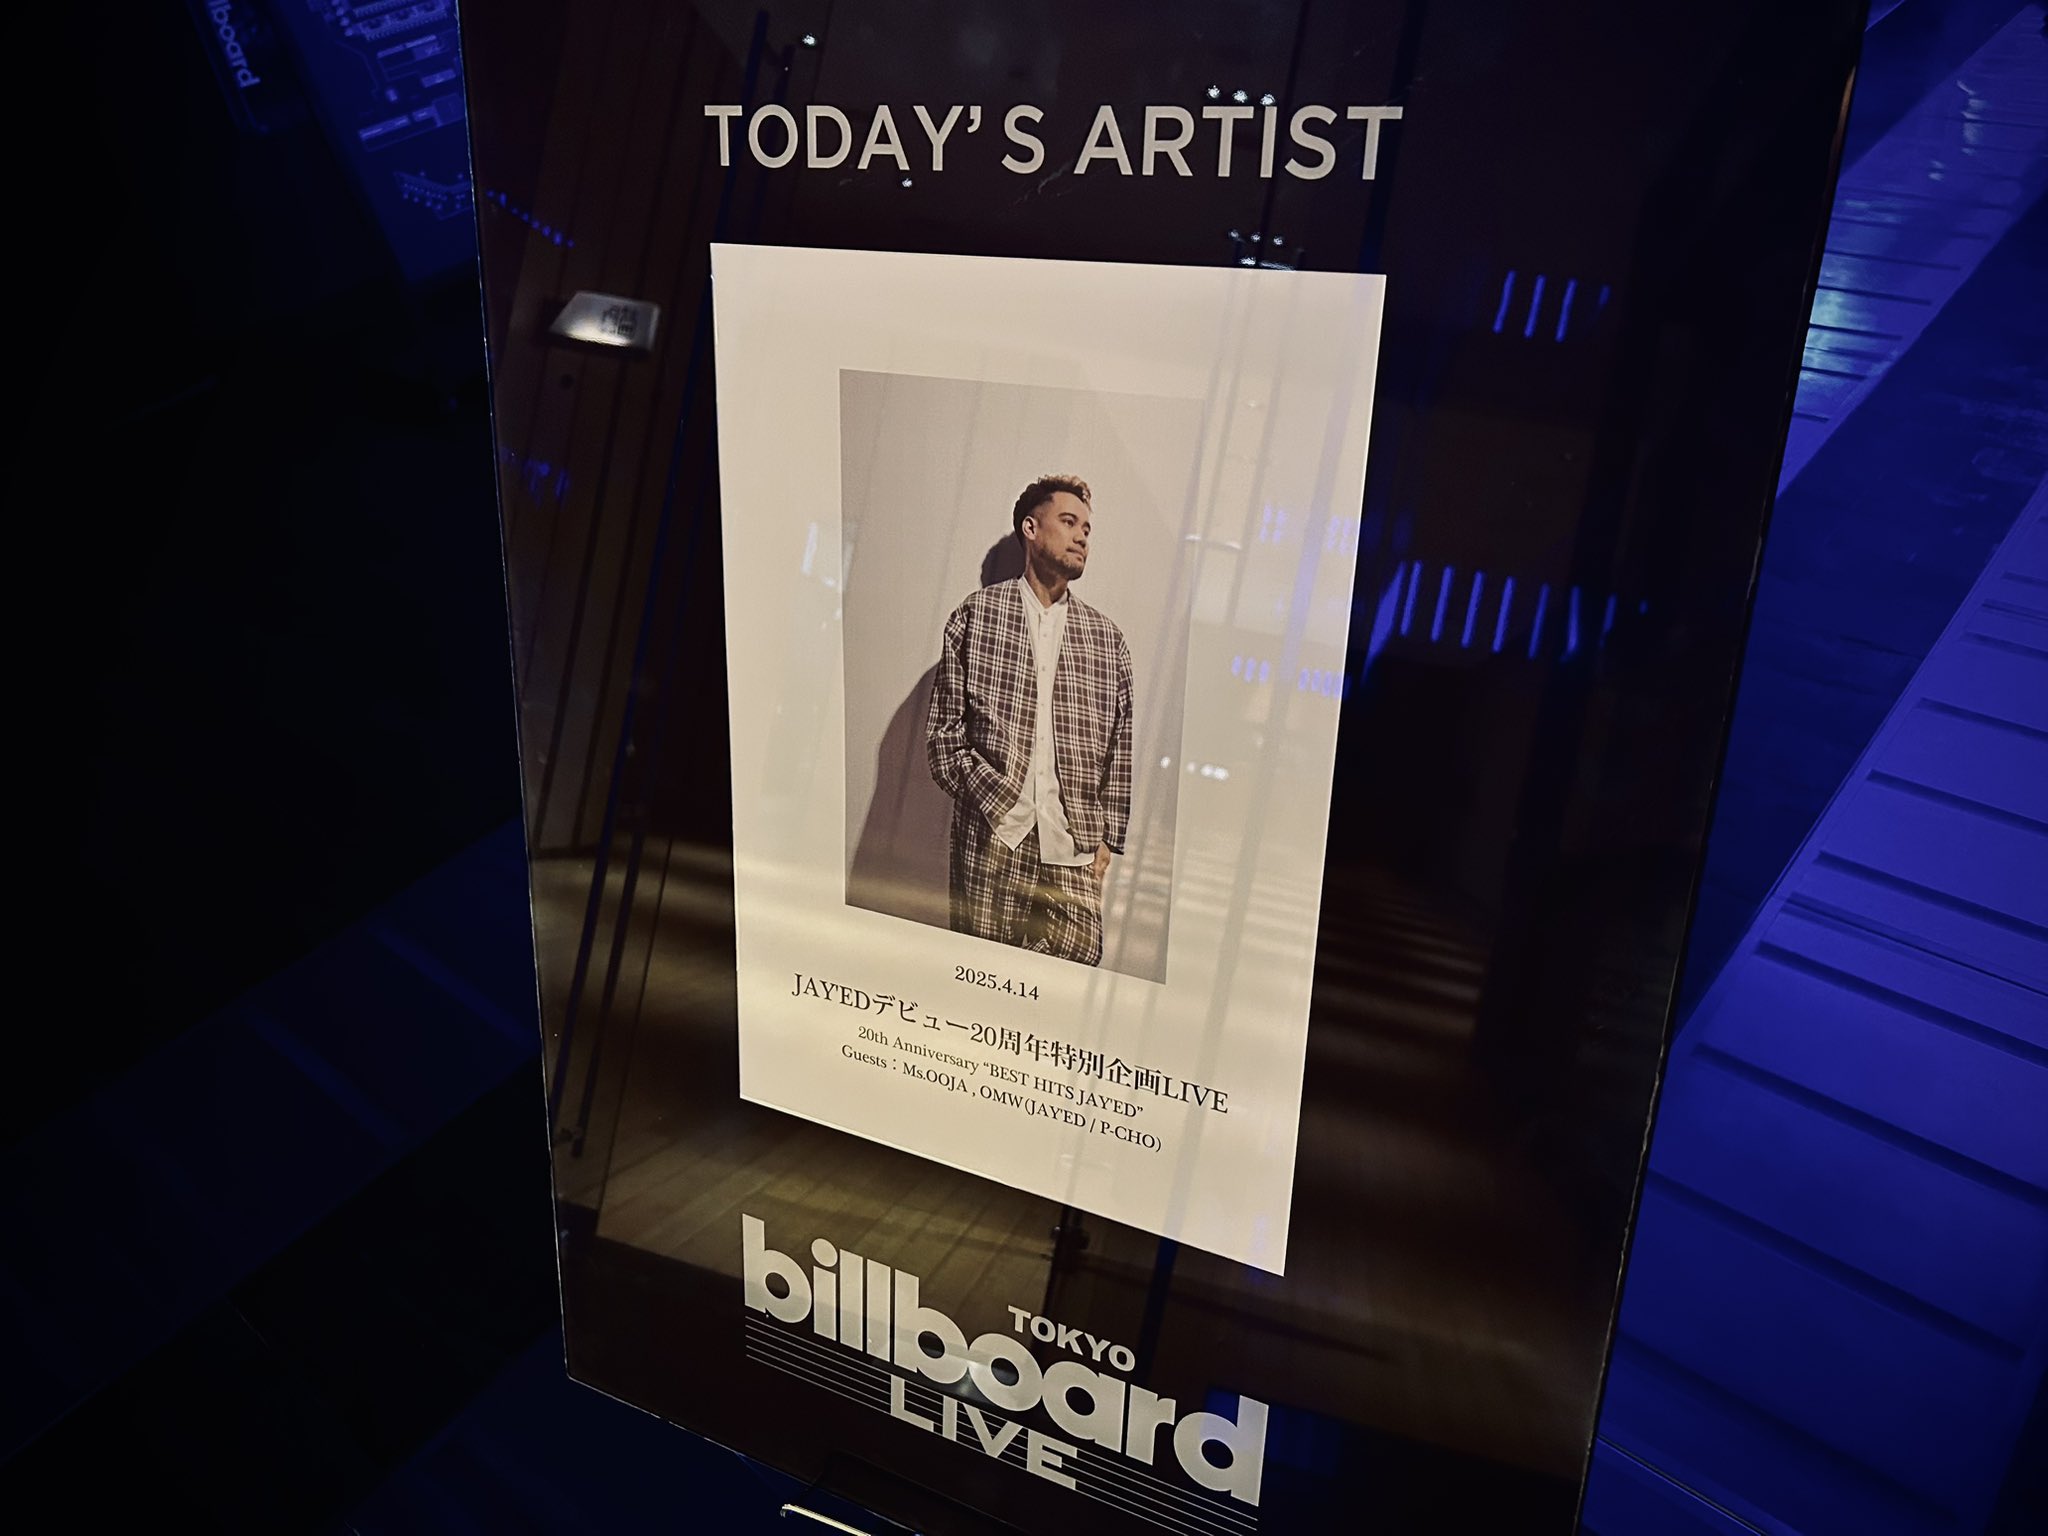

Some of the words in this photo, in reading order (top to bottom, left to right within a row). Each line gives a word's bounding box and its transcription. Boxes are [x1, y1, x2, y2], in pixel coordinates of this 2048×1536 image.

[1074, 105, 1404, 181] ARTIST
[954, 965, 1040, 1001] 2025.4.14
[857, 1025, 889, 1046] 20th
[892, 1035, 980, 1076] Anniversary
[1033, 1075, 1075, 1100] HITS
[1099, 1120, 1163, 1153] P-CHO)
[742, 1212, 1270, 1507] billboard
[1008, 1304, 1136, 1372] TOKYO
[890, 1374, 1078, 1490] LIVE
